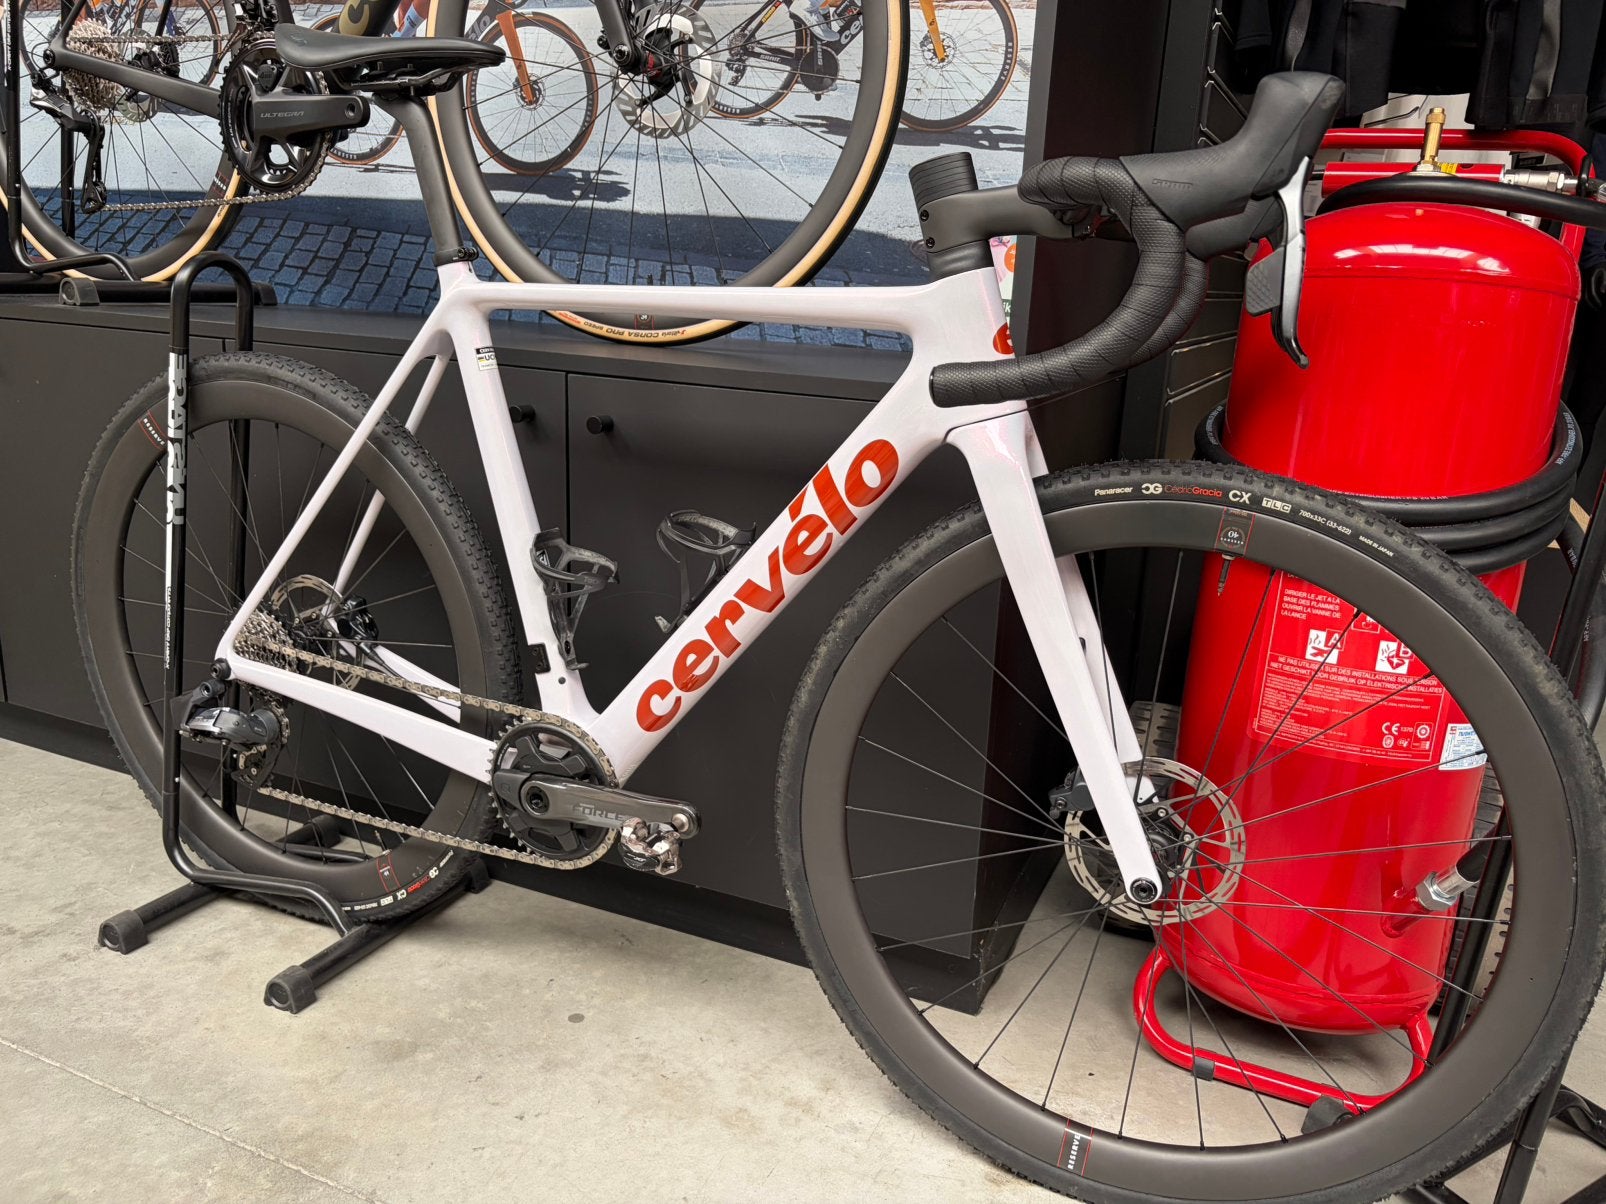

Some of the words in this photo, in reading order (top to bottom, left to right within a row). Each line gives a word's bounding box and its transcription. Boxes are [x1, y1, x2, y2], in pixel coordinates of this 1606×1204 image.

[1094, 486, 1133, 496] Panaracer
[1228, 490, 1252, 504] CX
[1262, 498, 1292, 513] TLC
[1359, 535, 1373, 546] MADE
[1378, 545, 1395, 557] JAPAN
[636, 438, 900, 732] cervélo
[1382, 722, 1400, 735] CE
[1067, 1133, 1081, 1170] RESERVE
